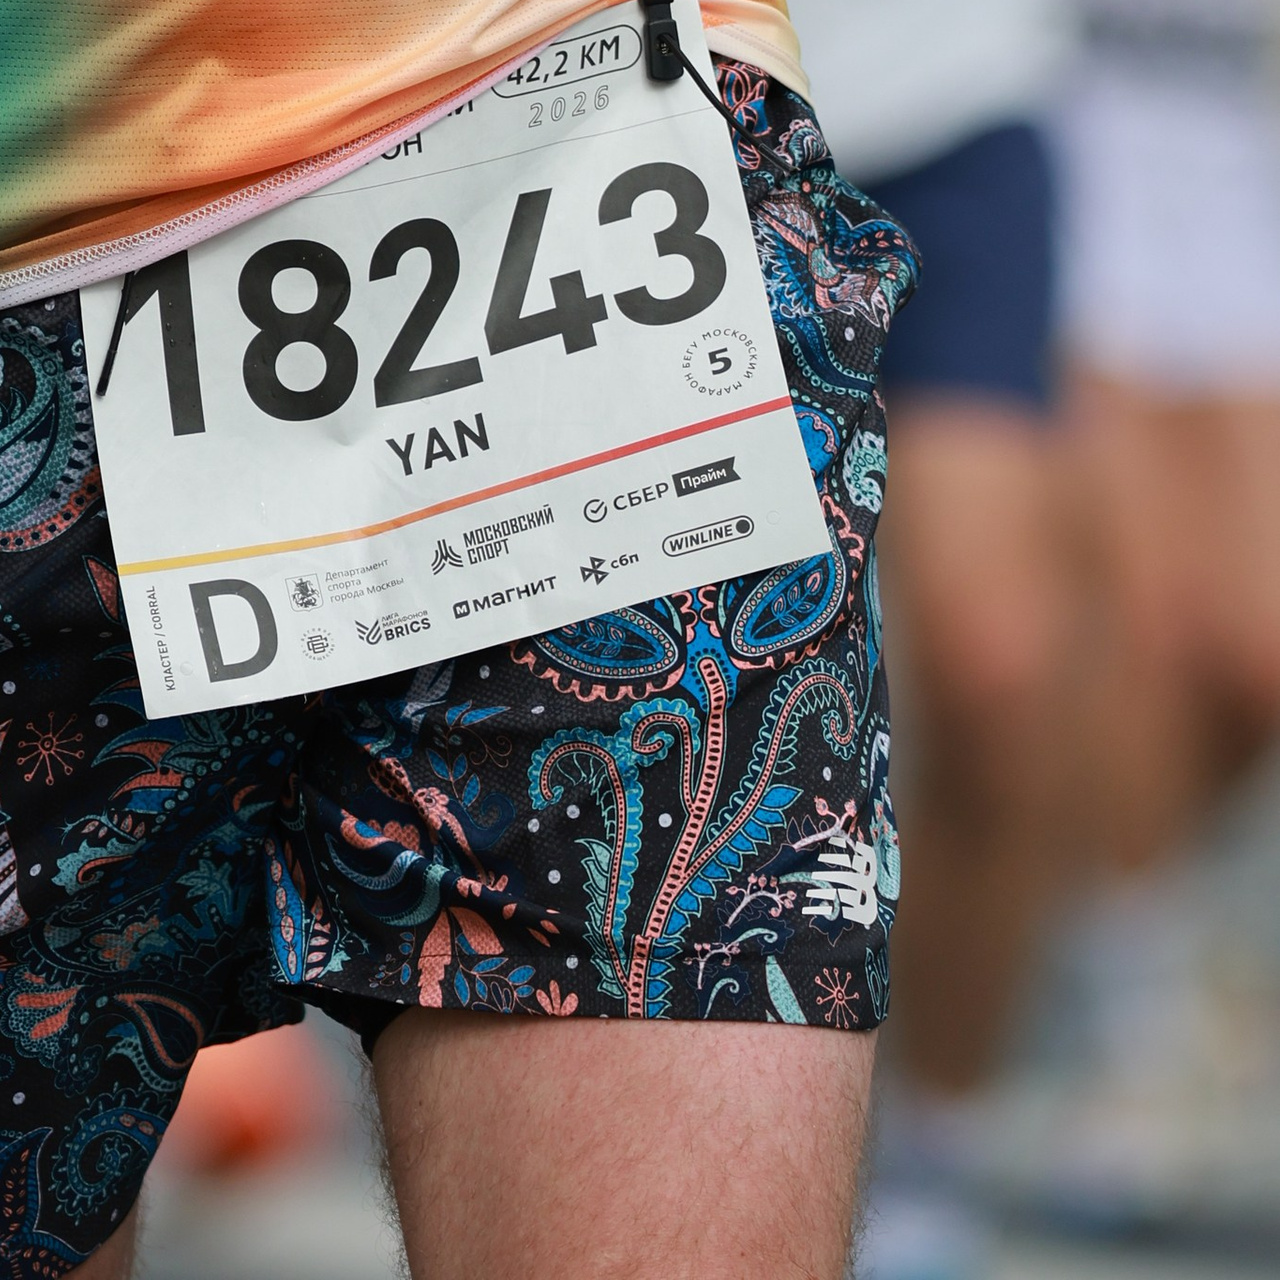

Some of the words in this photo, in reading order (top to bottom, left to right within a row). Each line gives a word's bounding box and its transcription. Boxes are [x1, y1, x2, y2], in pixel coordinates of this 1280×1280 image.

[528, 85, 610, 128] 2026
[124, 161, 728, 437] 18243
[682, 341, 698, 369] БЕГУ
[702, 328, 758, 379] МОСКОВСКИЙ
[708, 347, 732, 375] 5
[684, 373, 742, 396] МАРАФОН
[385, 413, 491, 476] YAN
[613, 482, 670, 511] СБЕР
[680, 467, 727, 490] Прайм
[463, 504, 555, 548] МОСКОВСКИЙ
[669, 524, 734, 552] WINLINE
[467, 538, 510, 565] СПОРТ
[325, 559, 389, 583] Департамент
[327, 578, 362, 592] спорта
[330, 590, 364, 603] города
[367, 577, 404, 594] Москвы
[146, 586, 163, 630] CORRAL
[188, 579, 278, 683] D
[384, 618, 431, 641] BRICS
[157, 640, 176, 691] КЛАСТЕР
